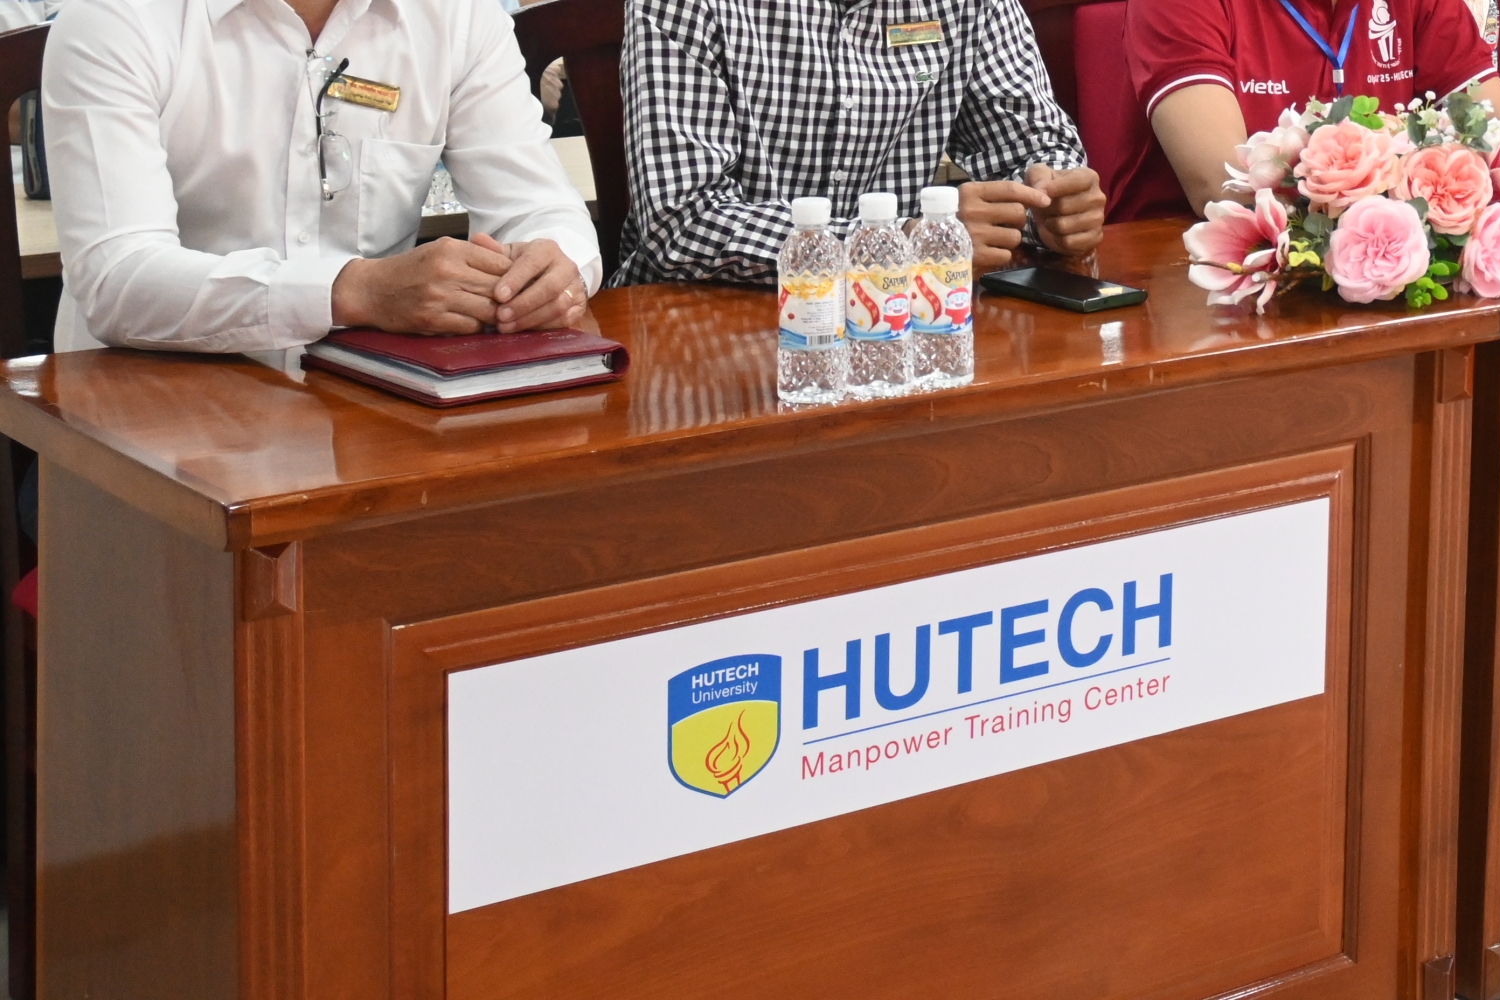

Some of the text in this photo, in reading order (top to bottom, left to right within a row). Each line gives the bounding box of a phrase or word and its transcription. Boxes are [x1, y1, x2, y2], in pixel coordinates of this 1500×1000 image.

[692, 662, 759, 689] HUTECH
[802, 571, 1173, 731] HUTECH
[692, 681, 758, 704] University
[801, 671, 1171, 780] Manpower Training Center
